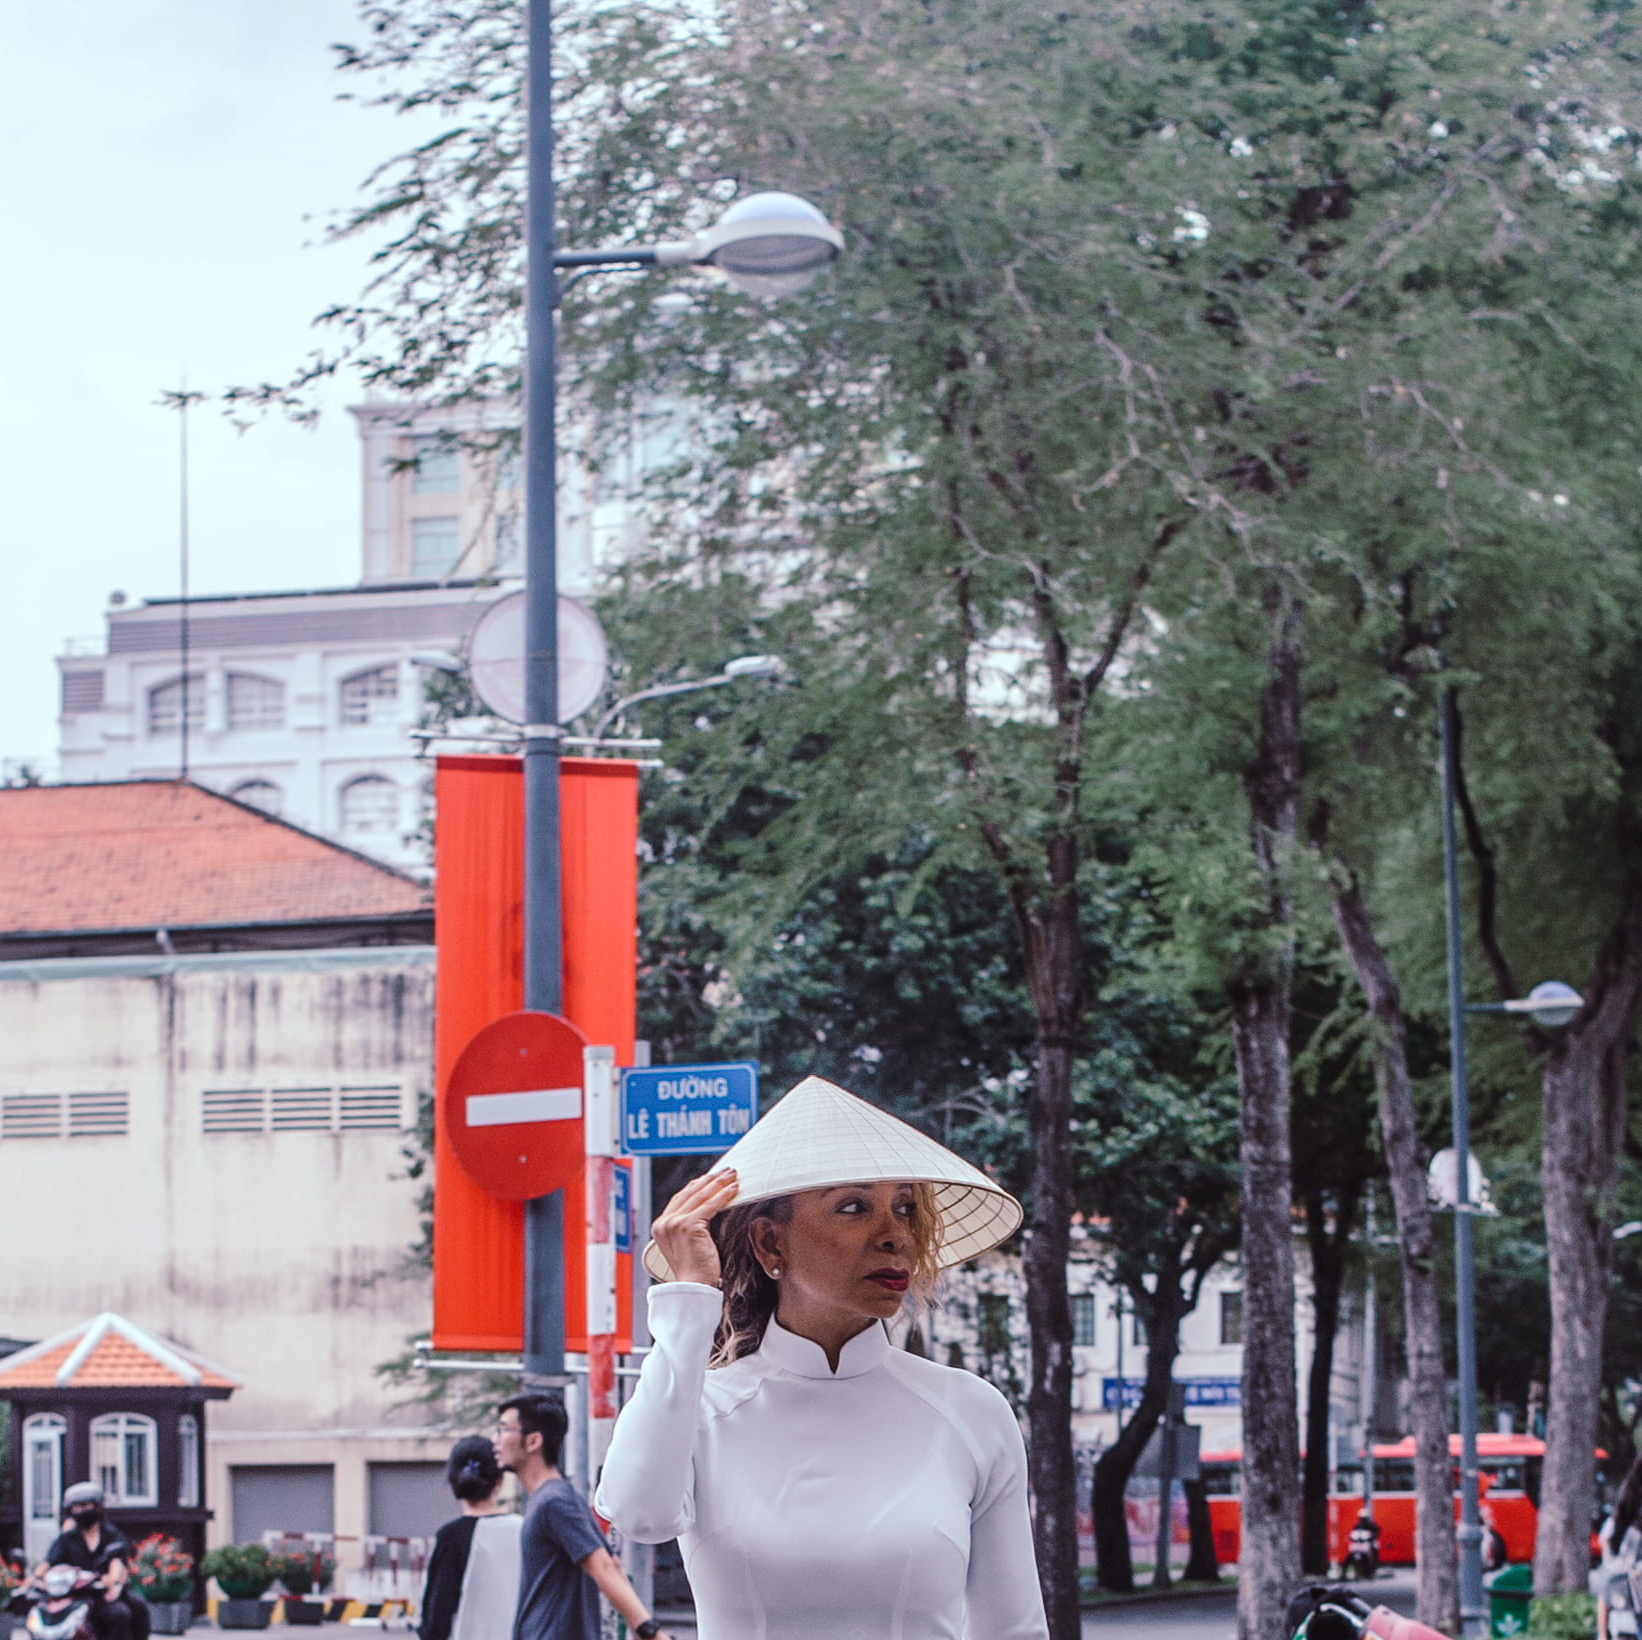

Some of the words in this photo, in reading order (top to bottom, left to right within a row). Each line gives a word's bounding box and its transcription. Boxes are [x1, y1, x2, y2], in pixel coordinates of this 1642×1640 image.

[657, 1075, 728, 1100] ĐƯỜNG
[628, 1107, 650, 1139] LÊ
[656, 1104, 712, 1138] THÁNH
[717, 1104, 750, 1135] TÔN
